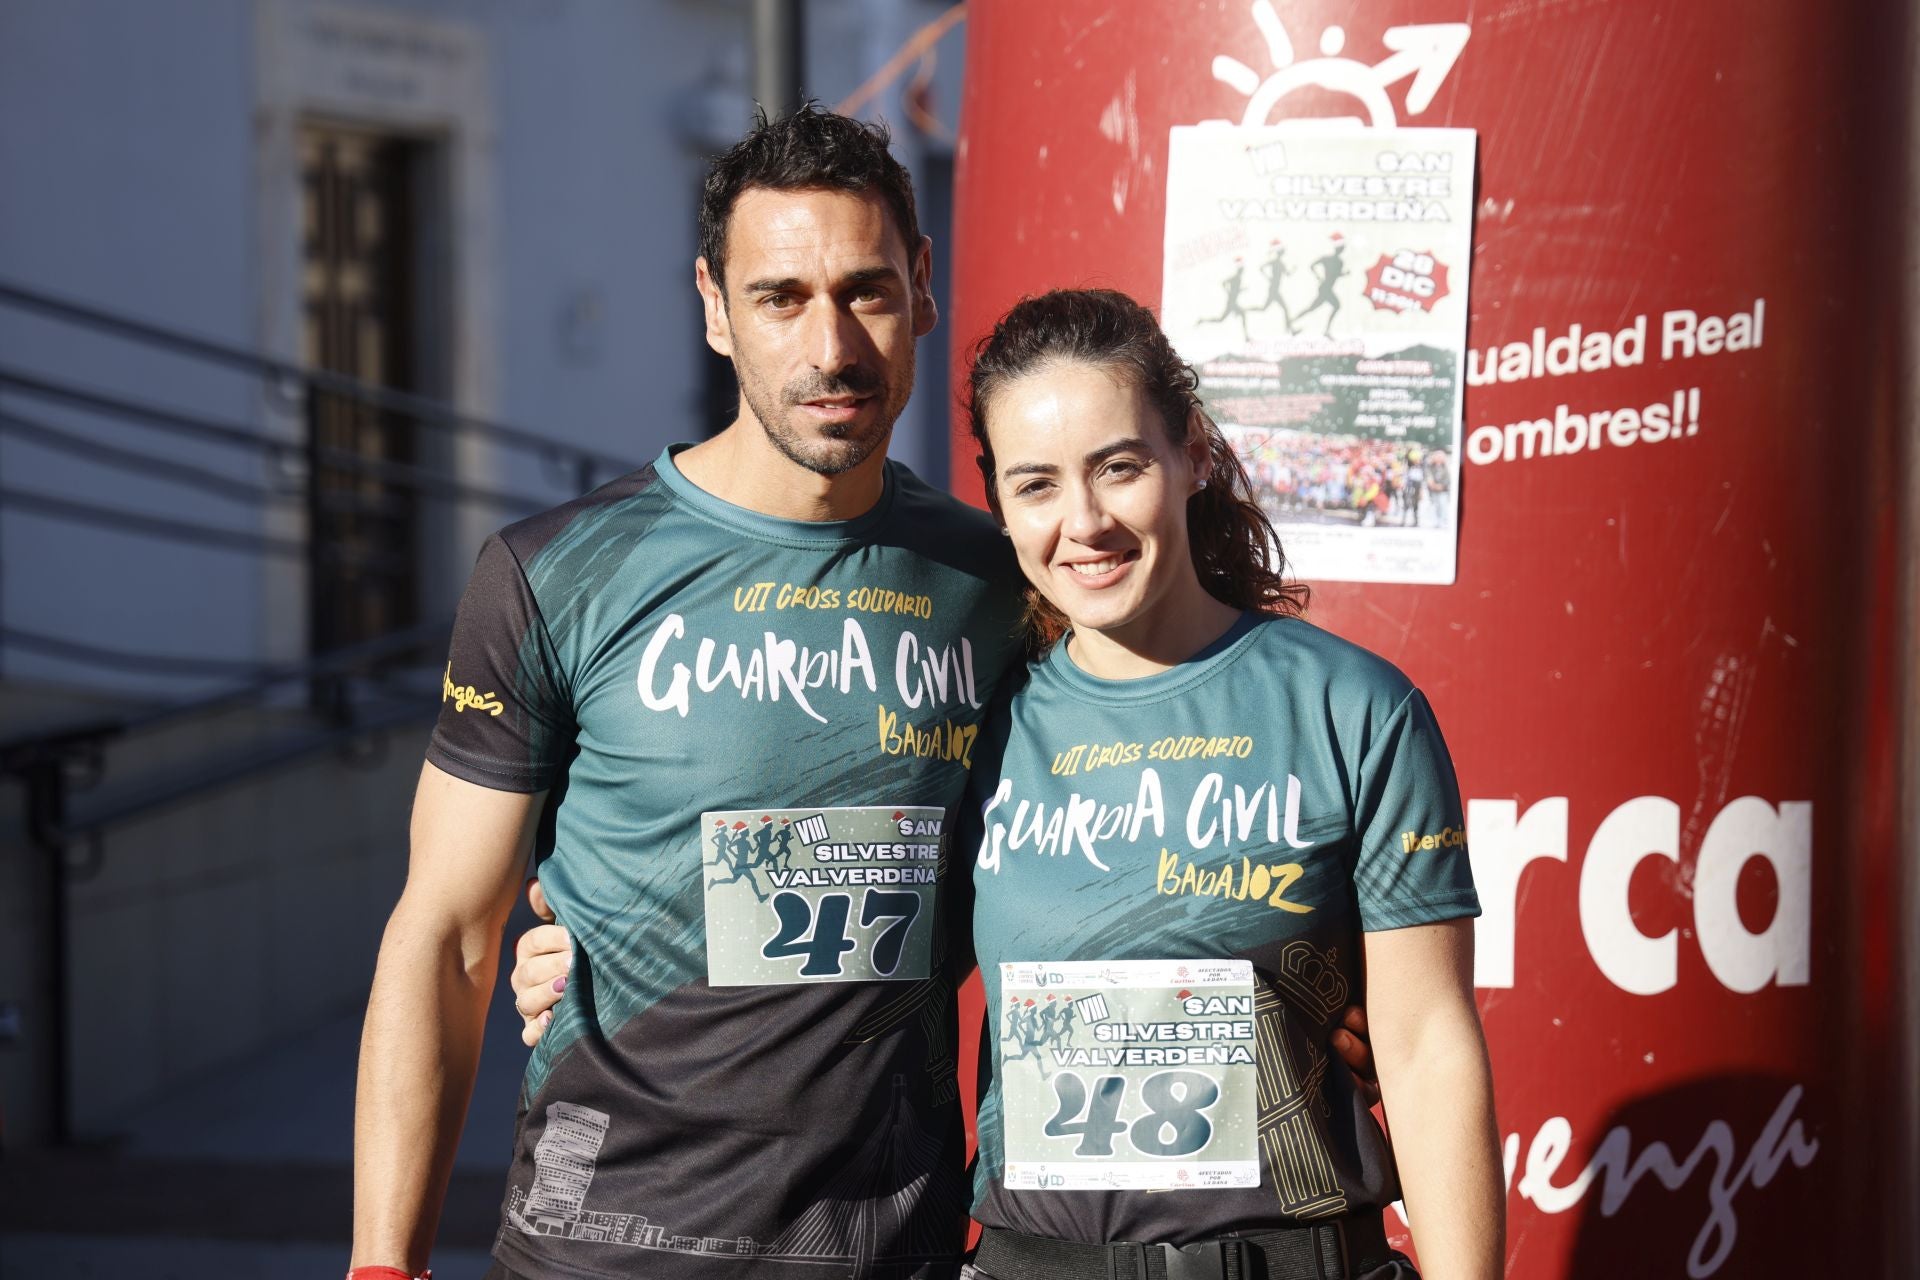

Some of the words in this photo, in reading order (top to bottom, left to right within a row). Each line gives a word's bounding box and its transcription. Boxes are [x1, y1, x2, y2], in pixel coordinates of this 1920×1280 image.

[1377, 151, 1450, 173] SAN
[1272, 175, 1450, 198] SILVESTRE
[1219, 197, 1450, 222] VALVERDEÑA
[1379, 265, 1436, 297] DIC
[1466, 314, 1647, 386] ualdad
[1661, 298, 1765, 361] Real
[1466, 387, 1700, 465] ombres!!
[776, 582, 841, 611] CROSS
[847, 586, 932, 619] SOLIDARIO
[637, 613, 877, 724] GUARDIA
[895, 630, 982, 710] CIVIL
[879, 704, 978, 770] BADAJOZ
[1085, 741, 1144, 772] CROSS
[1147, 736, 1253, 761] SOLIDARIO
[795, 814, 829, 846] VIII
[899, 820, 942, 836] SAN
[977, 768, 1165, 875] GUARDIA
[1186, 772, 1315, 850] CIVIL
[815, 844, 939, 862] SILVESTRE
[768, 866, 937, 887] VALVERDEÑA
[1157, 847, 1316, 914] BADAJOZ
[1467, 795, 1813, 996] rca
[761, 887, 922, 977] 47
[1076, 993, 1109, 1025] VIII
[1184, 996, 1252, 1015] SAN
[1095, 1022, 1253, 1041] SILVESTRE
[1051, 1044, 1255, 1066] VALVERDEÑA
[1043, 1069, 1222, 1158] 48
